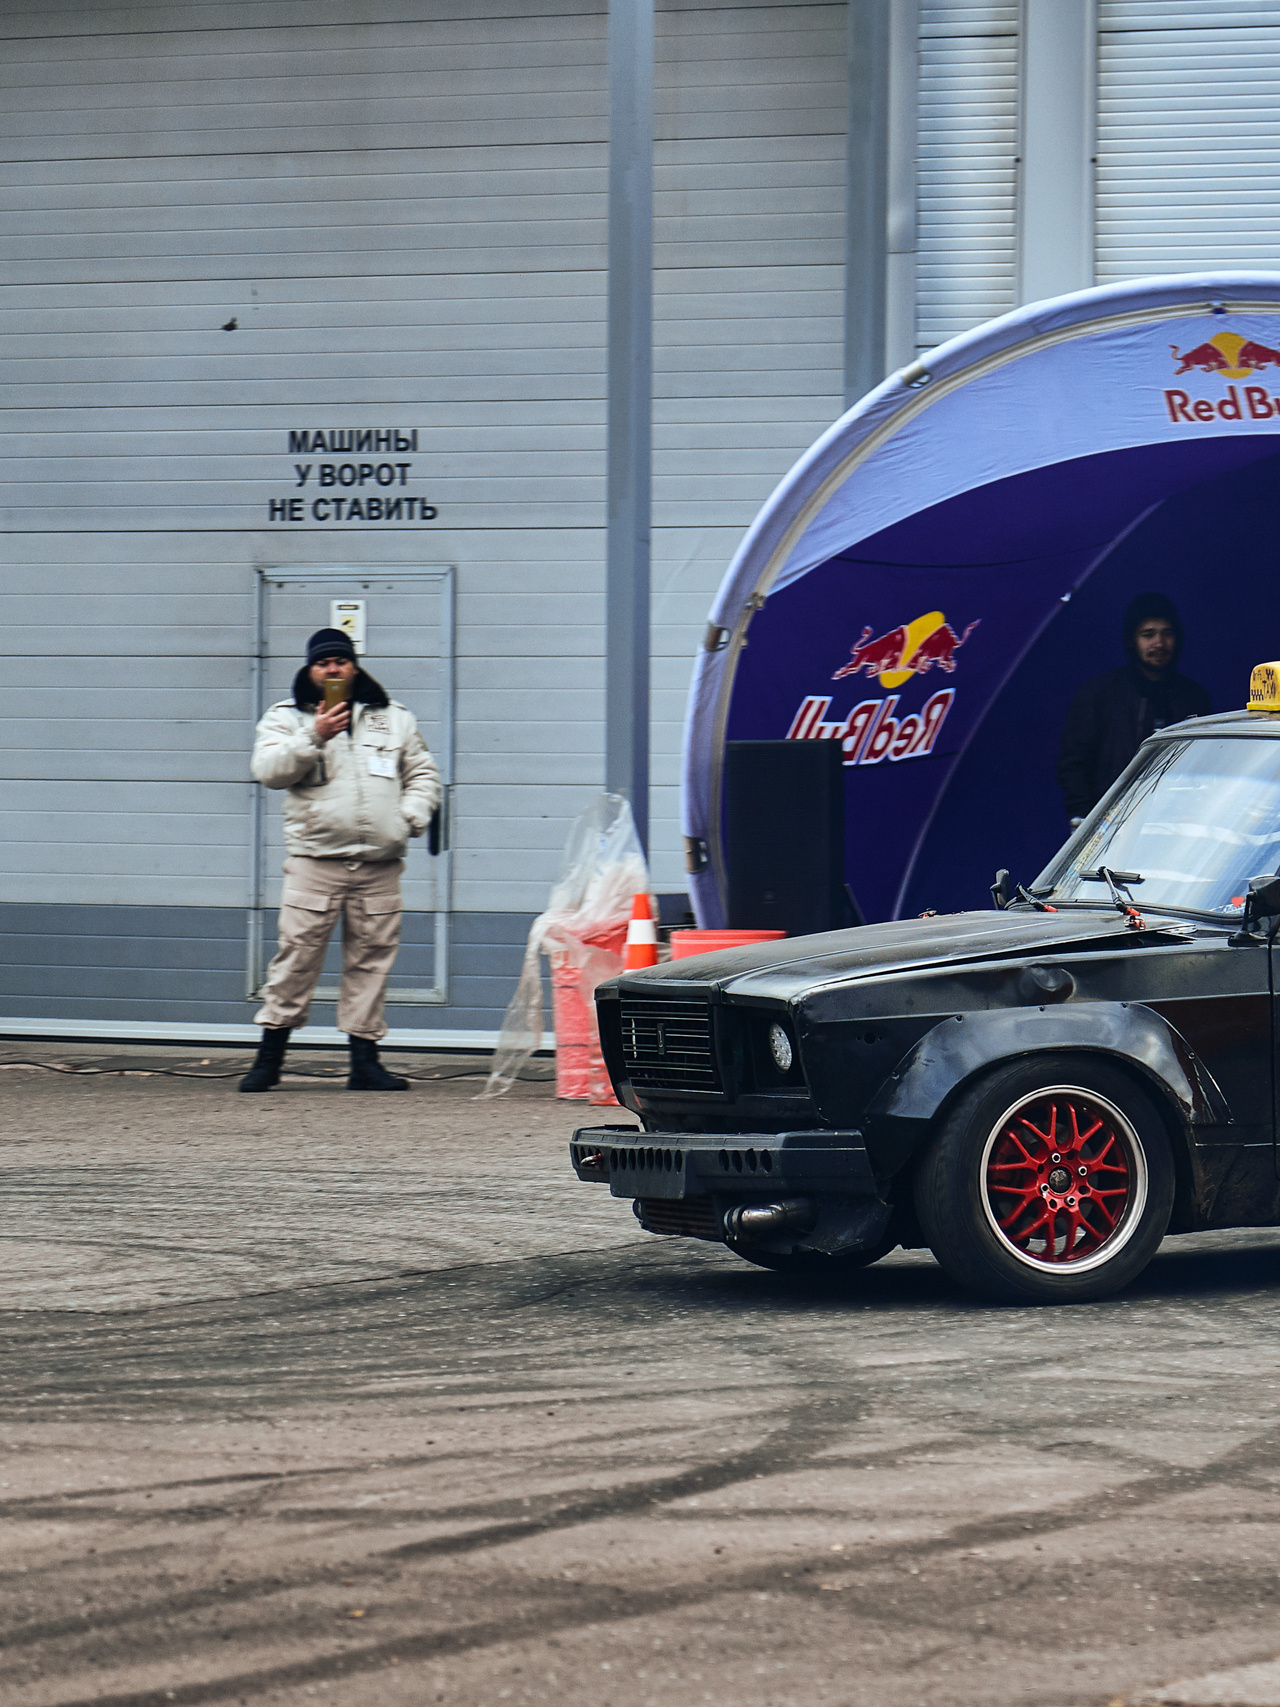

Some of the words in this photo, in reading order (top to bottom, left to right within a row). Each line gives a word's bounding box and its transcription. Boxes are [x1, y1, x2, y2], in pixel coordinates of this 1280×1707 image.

[1163, 385, 1244, 423] Red
[288, 429, 418, 453] МАШИНЫ
[294, 464, 313, 487] У
[318, 463, 412, 487] ВОРОТ
[269, 498, 305, 521] НЕ
[312, 497, 438, 521] СТАВИТЬ
